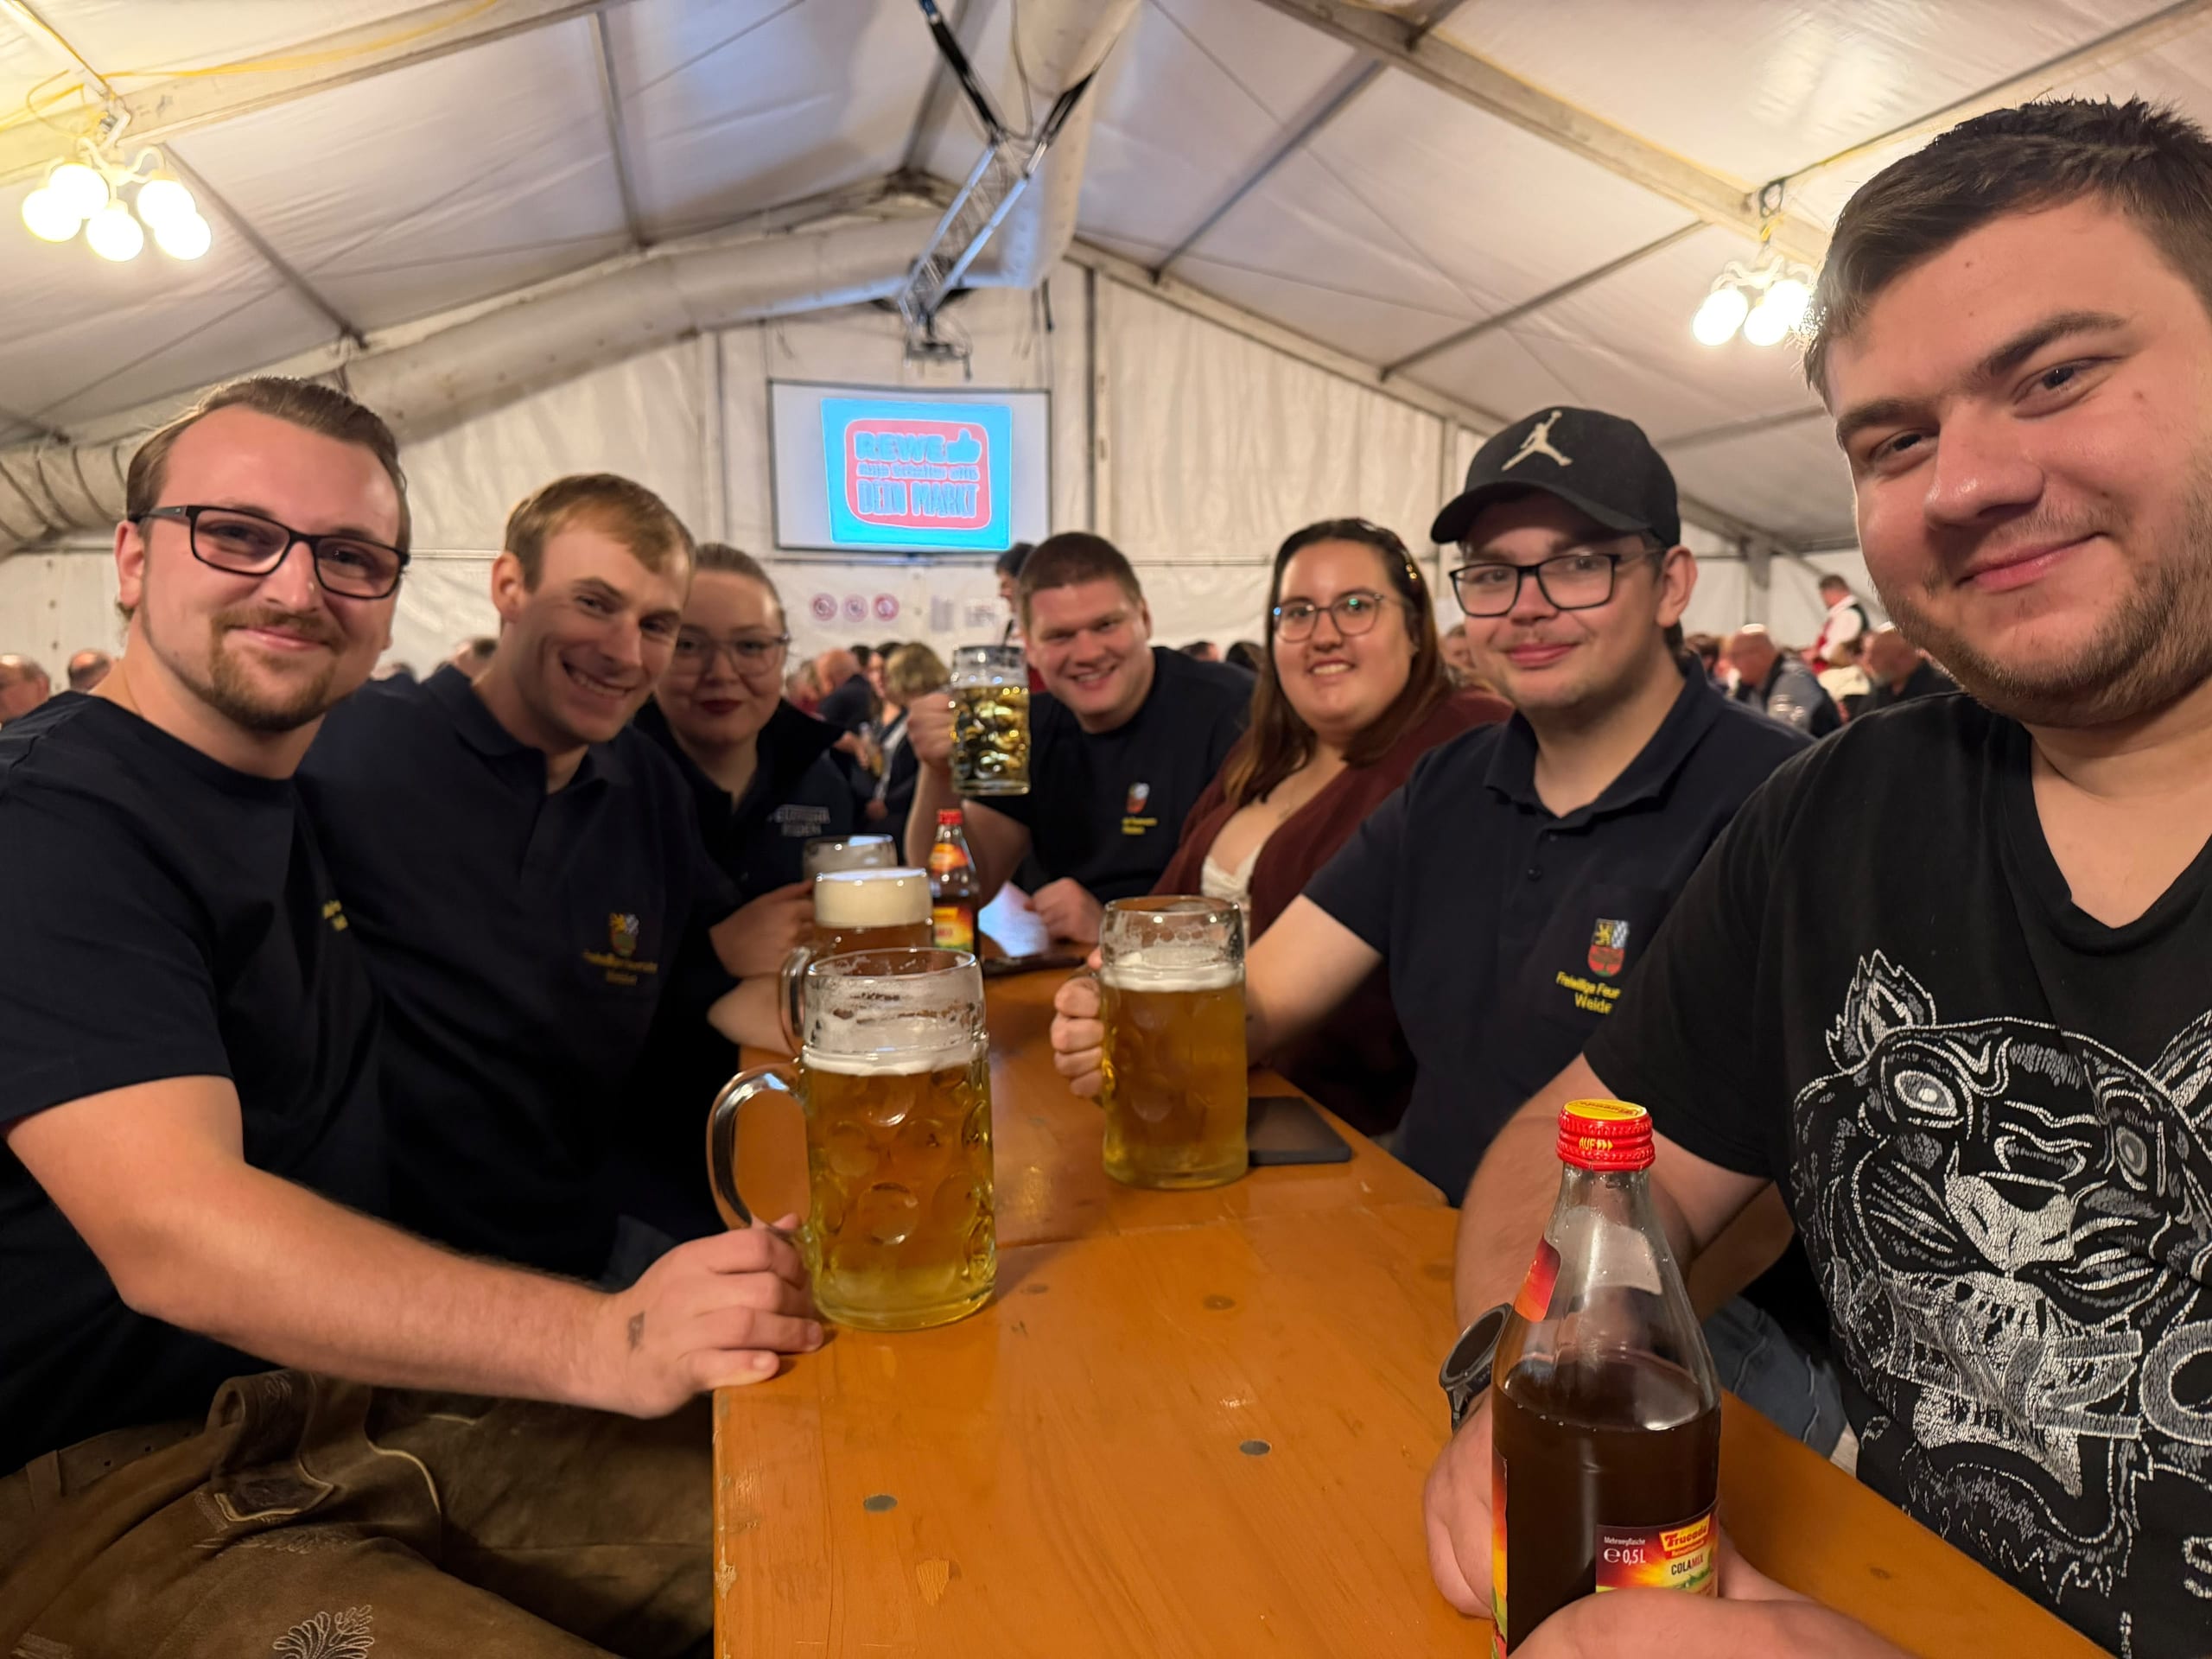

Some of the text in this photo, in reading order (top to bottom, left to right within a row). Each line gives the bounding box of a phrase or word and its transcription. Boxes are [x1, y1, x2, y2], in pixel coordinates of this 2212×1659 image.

[855, 431, 945, 463] REWE
[911, 481, 979, 518] MARKT
[1579, 1136, 1596, 1150] AUF
